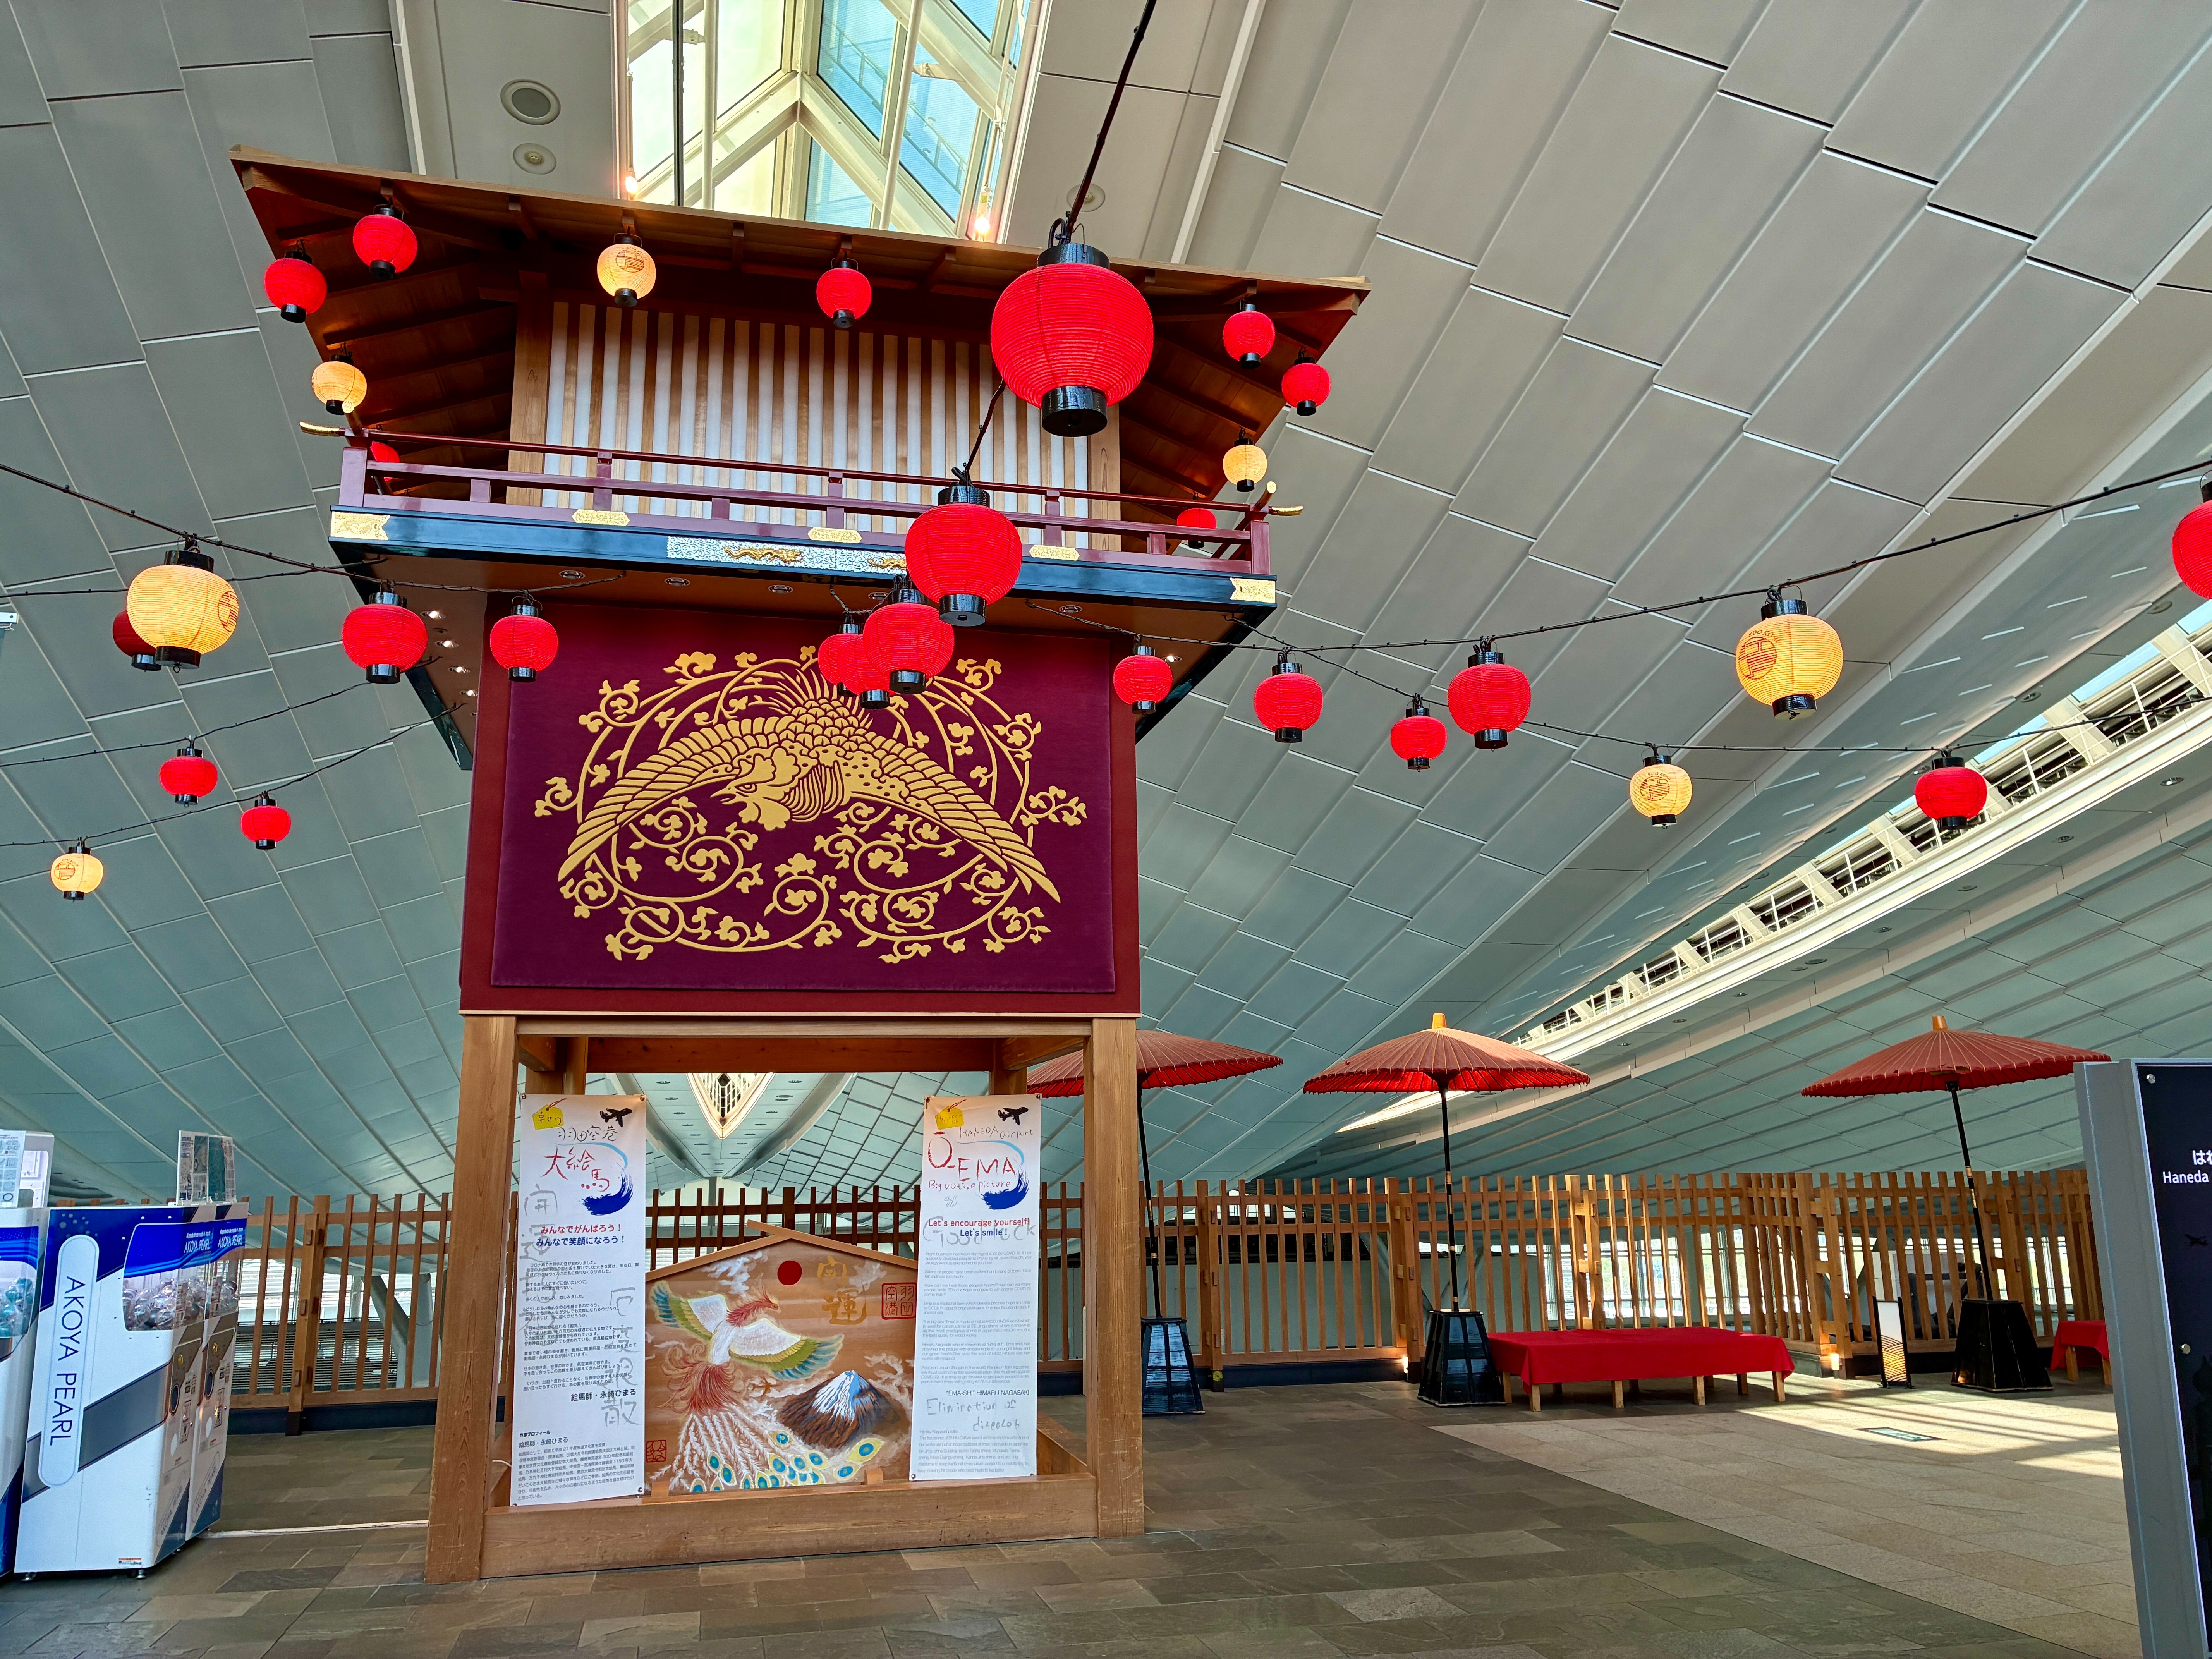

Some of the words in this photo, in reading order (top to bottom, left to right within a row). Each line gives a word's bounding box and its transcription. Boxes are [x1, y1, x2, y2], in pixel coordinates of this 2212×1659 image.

[558, 1125, 618, 1142] 羽田空港
[2163, 1170, 2209, 1183] Haneda
[929, 1180, 941, 1191] Big
[945, 1182, 976, 1190] votive
[979, 1181, 1010, 1193] picture
[541, 1224, 620, 1234] みんなでがんばろう！
[994, 1218, 1030, 1227] yourself!
[536, 1235, 624, 1247] みんなで笑顔になろう！
[58, 1276, 86, 1361] AKOYA
[570, 1388, 636, 1402] 絵馬師・永崎ひまる
[50, 1372, 77, 1446] PEARL
[519, 1437, 568, 1448] 絵馬師・永崎ひまる
